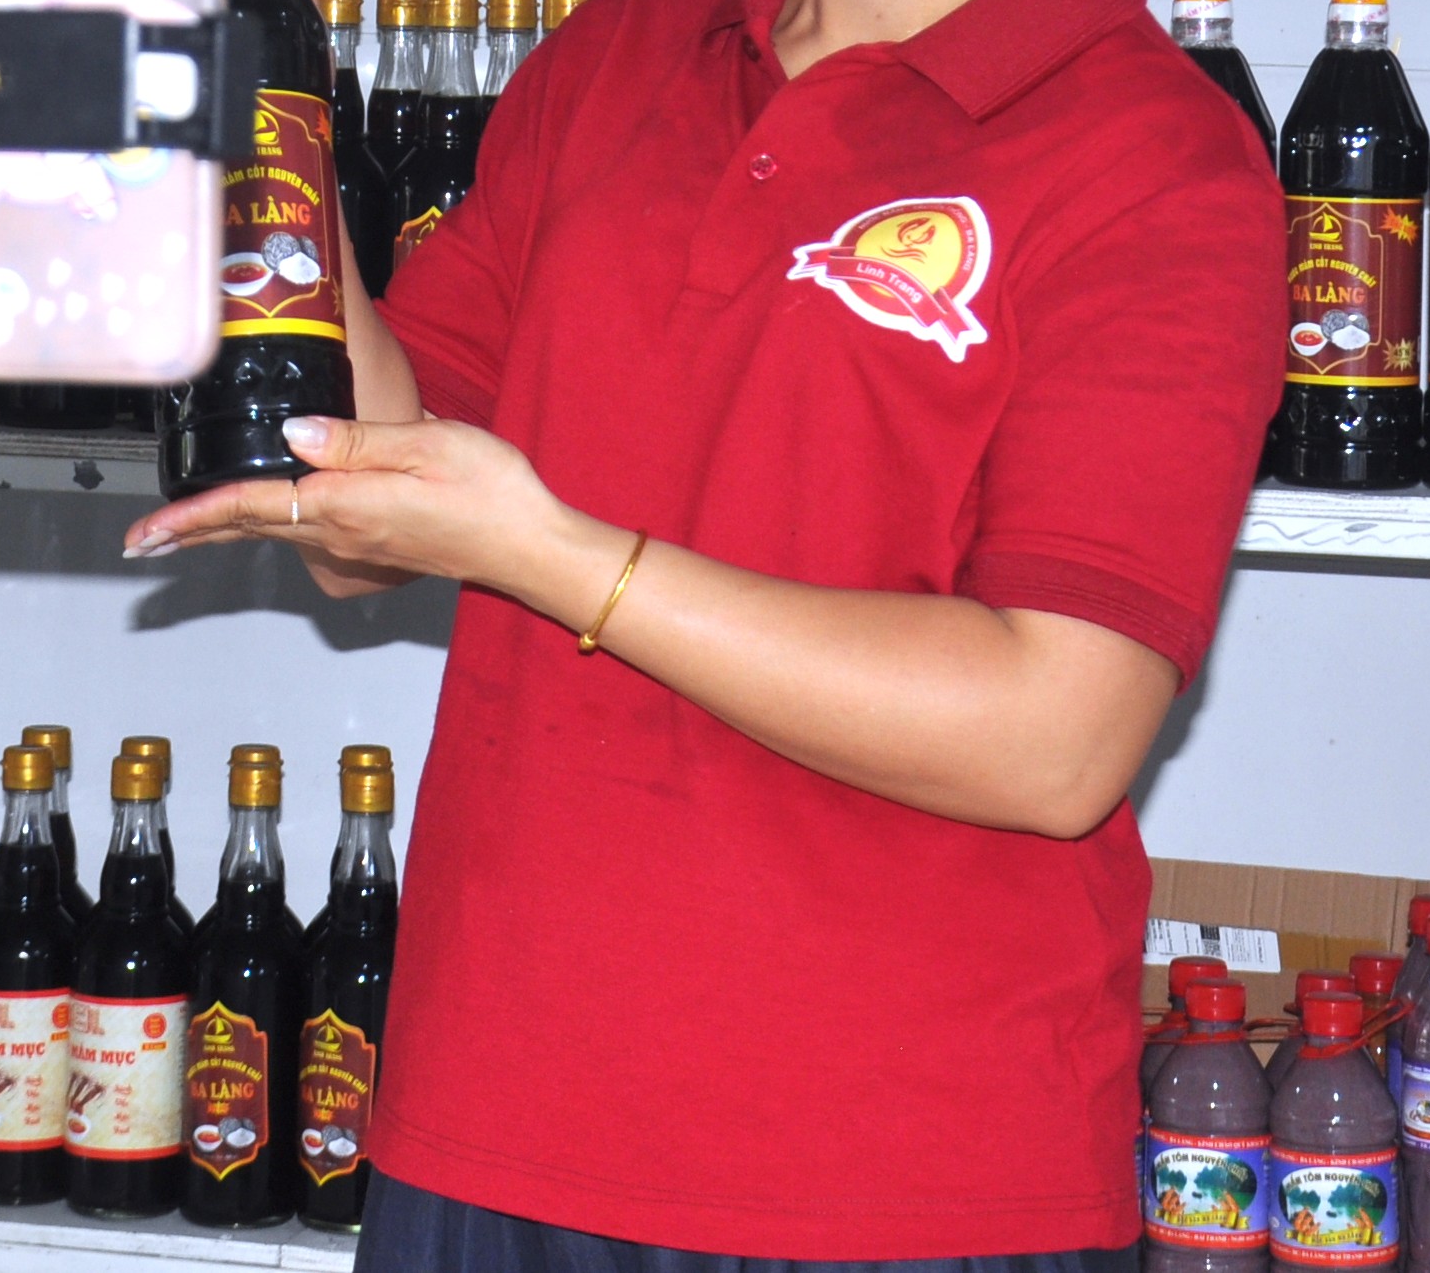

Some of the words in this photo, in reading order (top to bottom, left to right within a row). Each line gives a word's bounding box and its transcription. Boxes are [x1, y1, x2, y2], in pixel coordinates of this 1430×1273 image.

[268, 167, 303, 189] NGUYÊN
[225, 203, 244, 225] A
[250, 195, 312, 225] LÀNG
[856, 262, 885, 279] Linh
[888, 273, 923, 304] Trang
[1293, 284, 1311, 302] BA
[1315, 281, 1366, 304] LÀNG
[11, 1041, 46, 1059] MỤC
[100, 1051, 136, 1067] MỤC
[191, 1082, 207, 1098] BA
[211, 1078, 255, 1099] LÀNG
[317, 1086, 359, 1110] LÀNG
[1172, 1152, 1189, 1163] TÔM
[1303, 1172, 1322, 1183] TÔM
